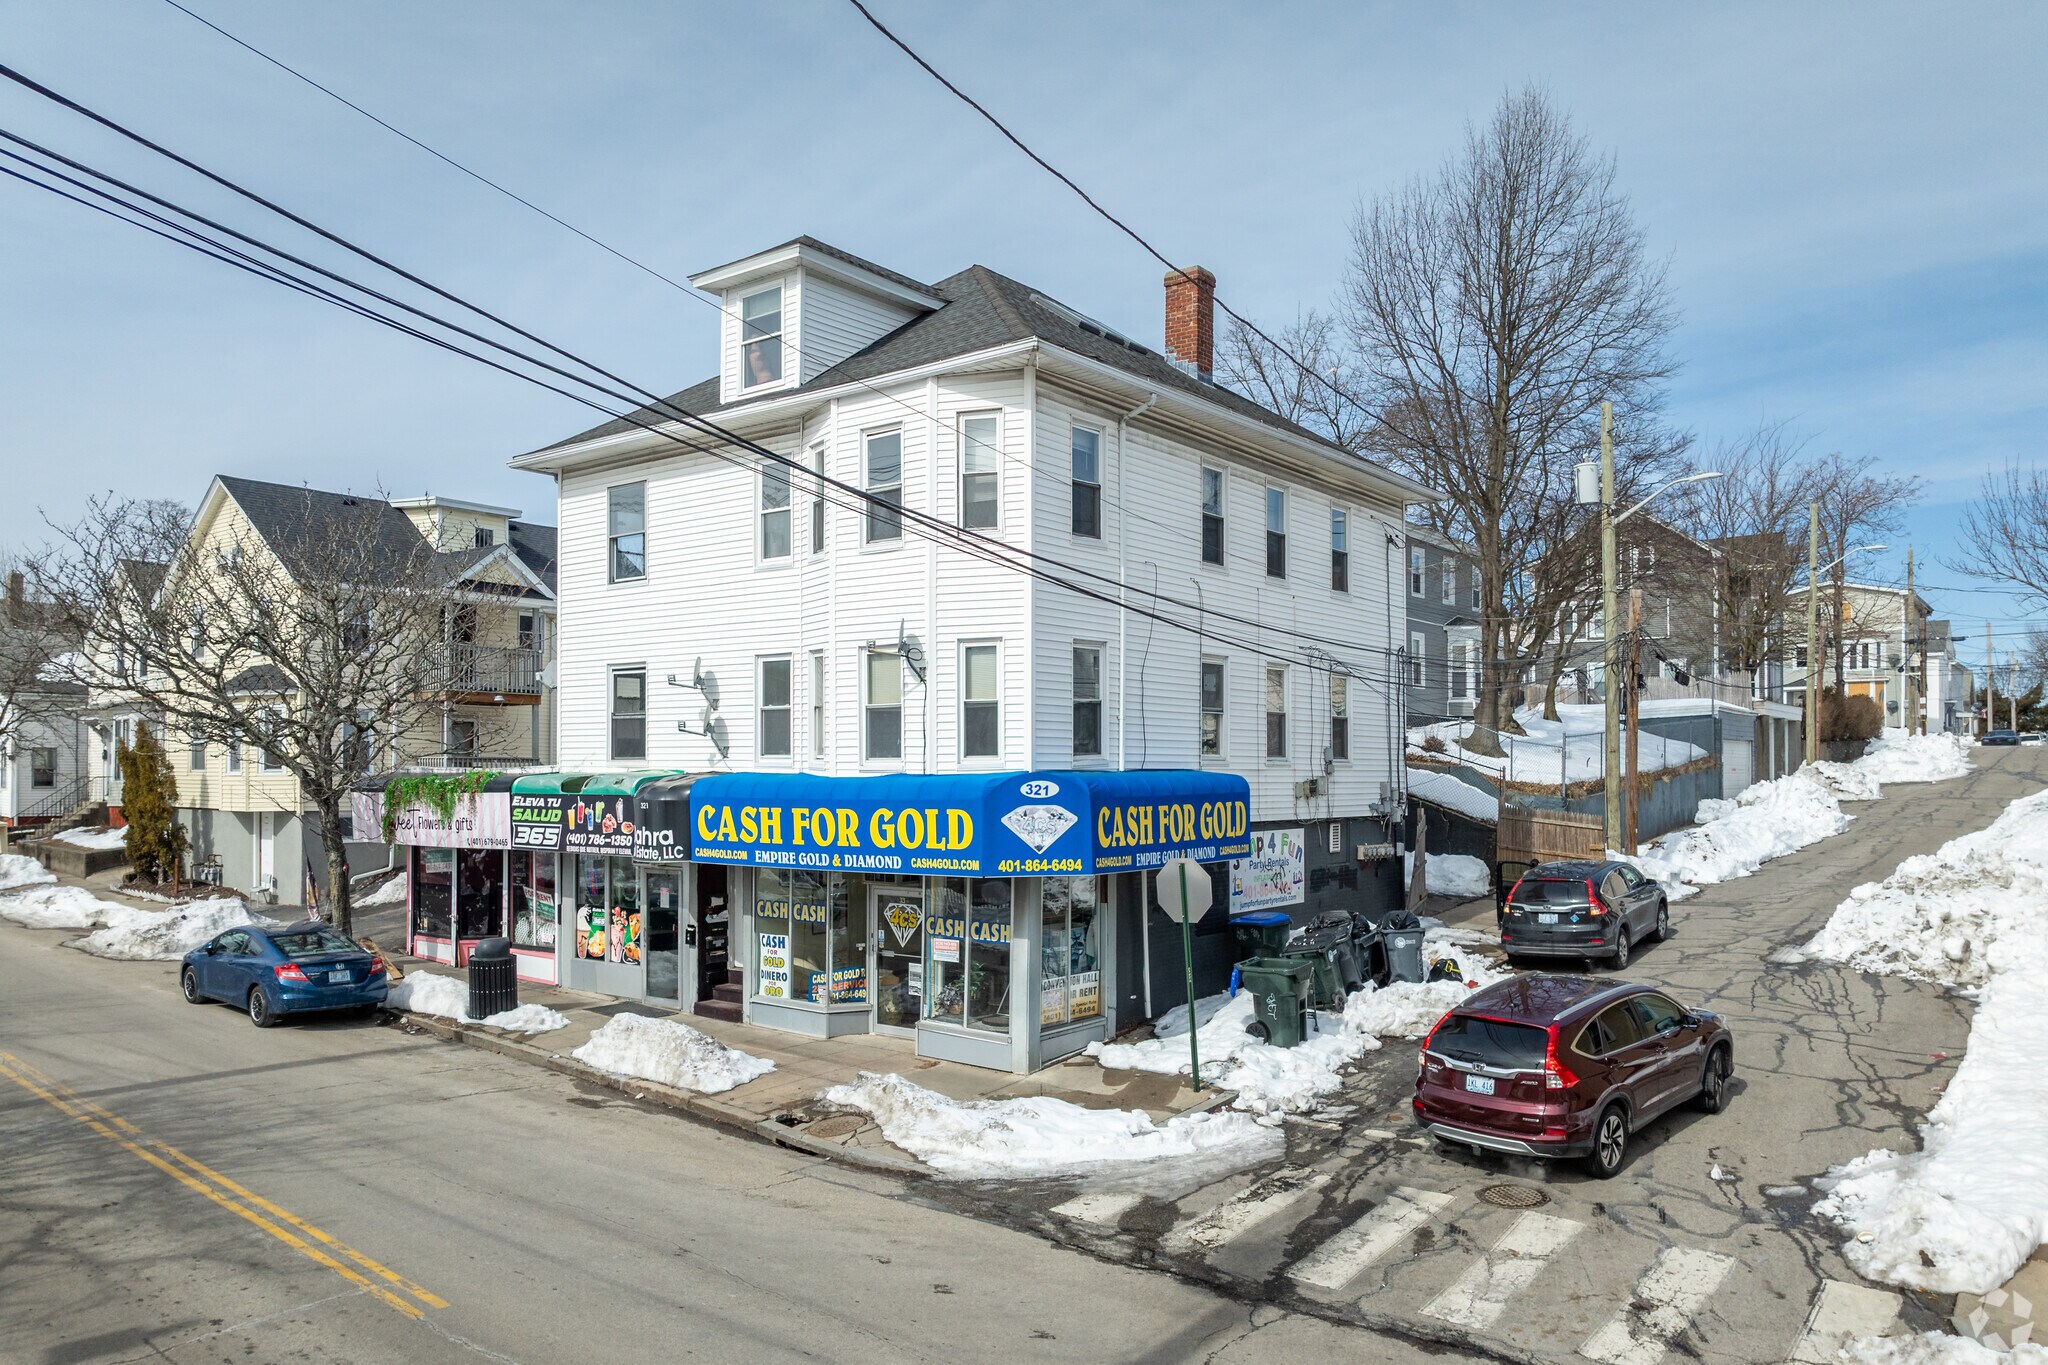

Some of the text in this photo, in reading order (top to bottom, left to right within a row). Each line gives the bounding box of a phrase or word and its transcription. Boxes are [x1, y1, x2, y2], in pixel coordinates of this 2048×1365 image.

[1025, 784, 1050, 796] 321
[512, 796, 561, 807] ELEVA TU
[512, 808, 562, 823] SALUD
[447, 817, 453, 830] &
[455, 817, 473, 833] gifts
[697, 804, 974, 851] CASH FOR GOLD
[1097, 801, 1247, 848] CASH FOR GOLD
[471, 838, 483, 847] (401)
[515, 827, 560, 845] 365
[566, 833, 633, 847] (401) 786-1350
[663, 846, 684, 859] LLC
[1268, 832, 1276, 854] 4
[1281, 833, 1303, 863] Fun
[695, 848, 980, 871] CASH4GOLD.COM EMPIRE GOLD & DIAMOND CASH4GOLD.COM
[1096, 856, 1132, 868] CASH4GOLD.COM
[1136, 851, 1161, 866] EMPIRE
[1162, 850, 1180, 864] GOLD
[1187, 846, 1216, 859] DIAMOND
[1219, 844, 1250, 856] CASH4GOLD.COM
[998, 859, 1083, 872] 401-864-6494
[1249, 857, 1290, 873] Party Rentals
[757, 900, 788, 919] CASH
[793, 904, 826, 923] CASH
[926, 917, 965, 938] CASH
[970, 921, 1010, 943] CASH
[761, 934, 786, 949] CASH
[763, 956, 785, 968] GOLD
[761, 969, 788, 982] DINERO
[844, 969, 860, 980] GOLD
[1083, 973, 1098, 983] HALL
[764, 985, 783, 997] ORO
[1080, 986, 1097, 998] RENT
[1482, 1081, 1493, 1090] 416
